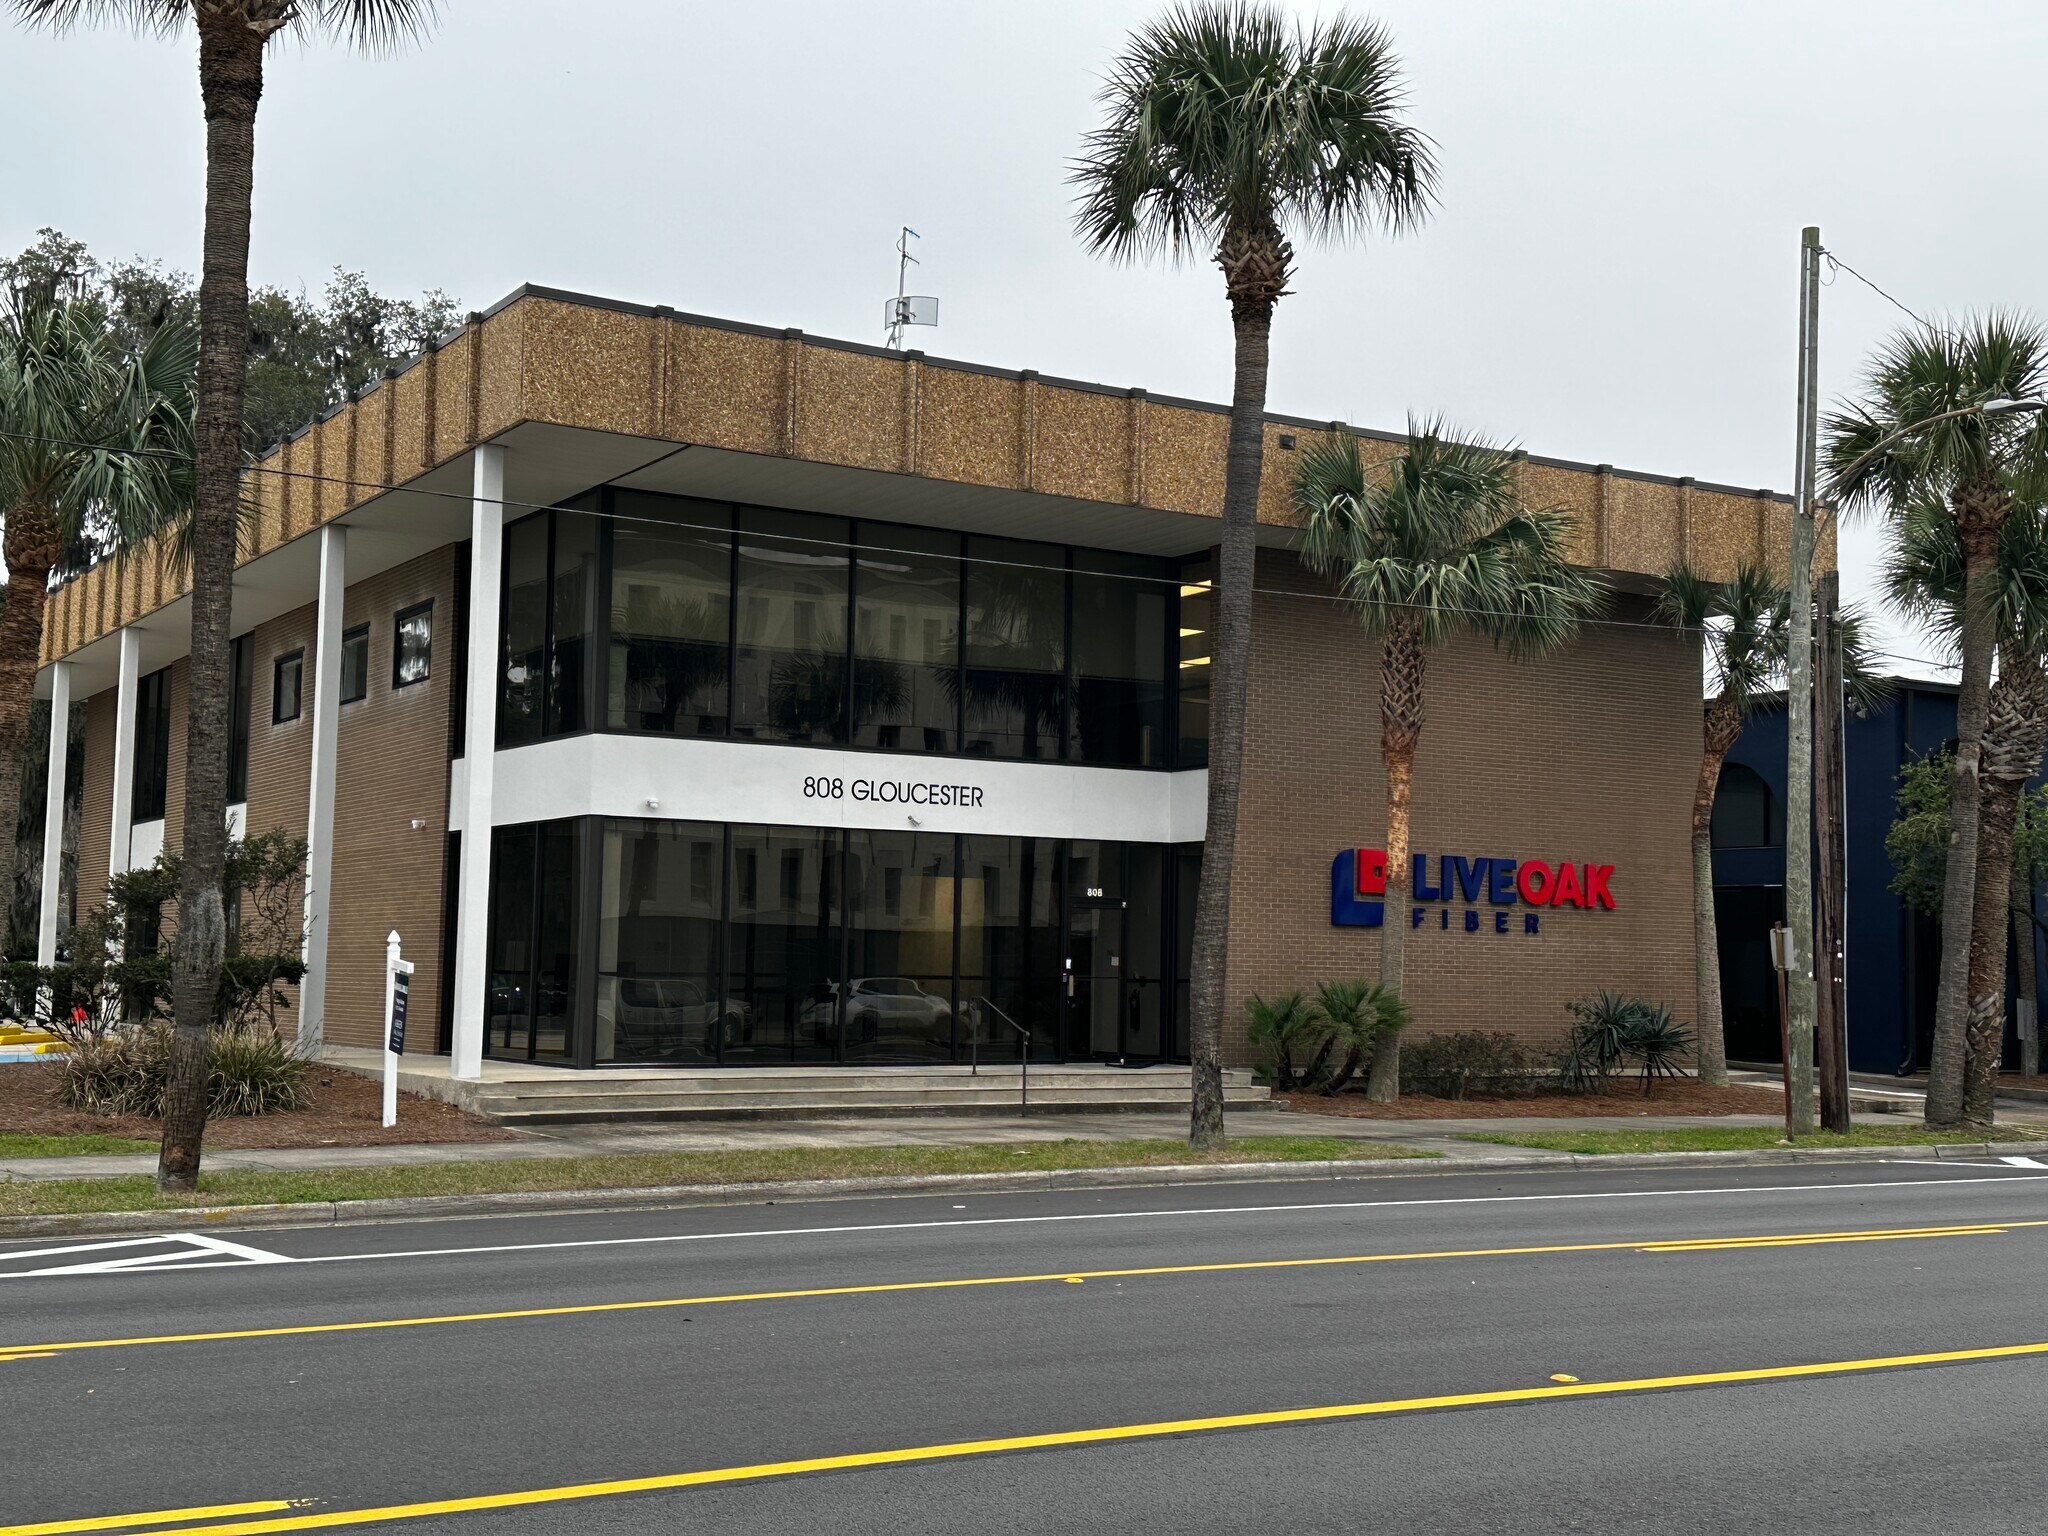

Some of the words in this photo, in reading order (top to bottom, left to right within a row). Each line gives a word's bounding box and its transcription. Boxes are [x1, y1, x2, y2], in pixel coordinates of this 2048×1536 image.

[803, 776, 843, 798] 808
[851, 779, 983, 807] GLOUCESTER
[1412, 909, 1539, 933] FIBER
